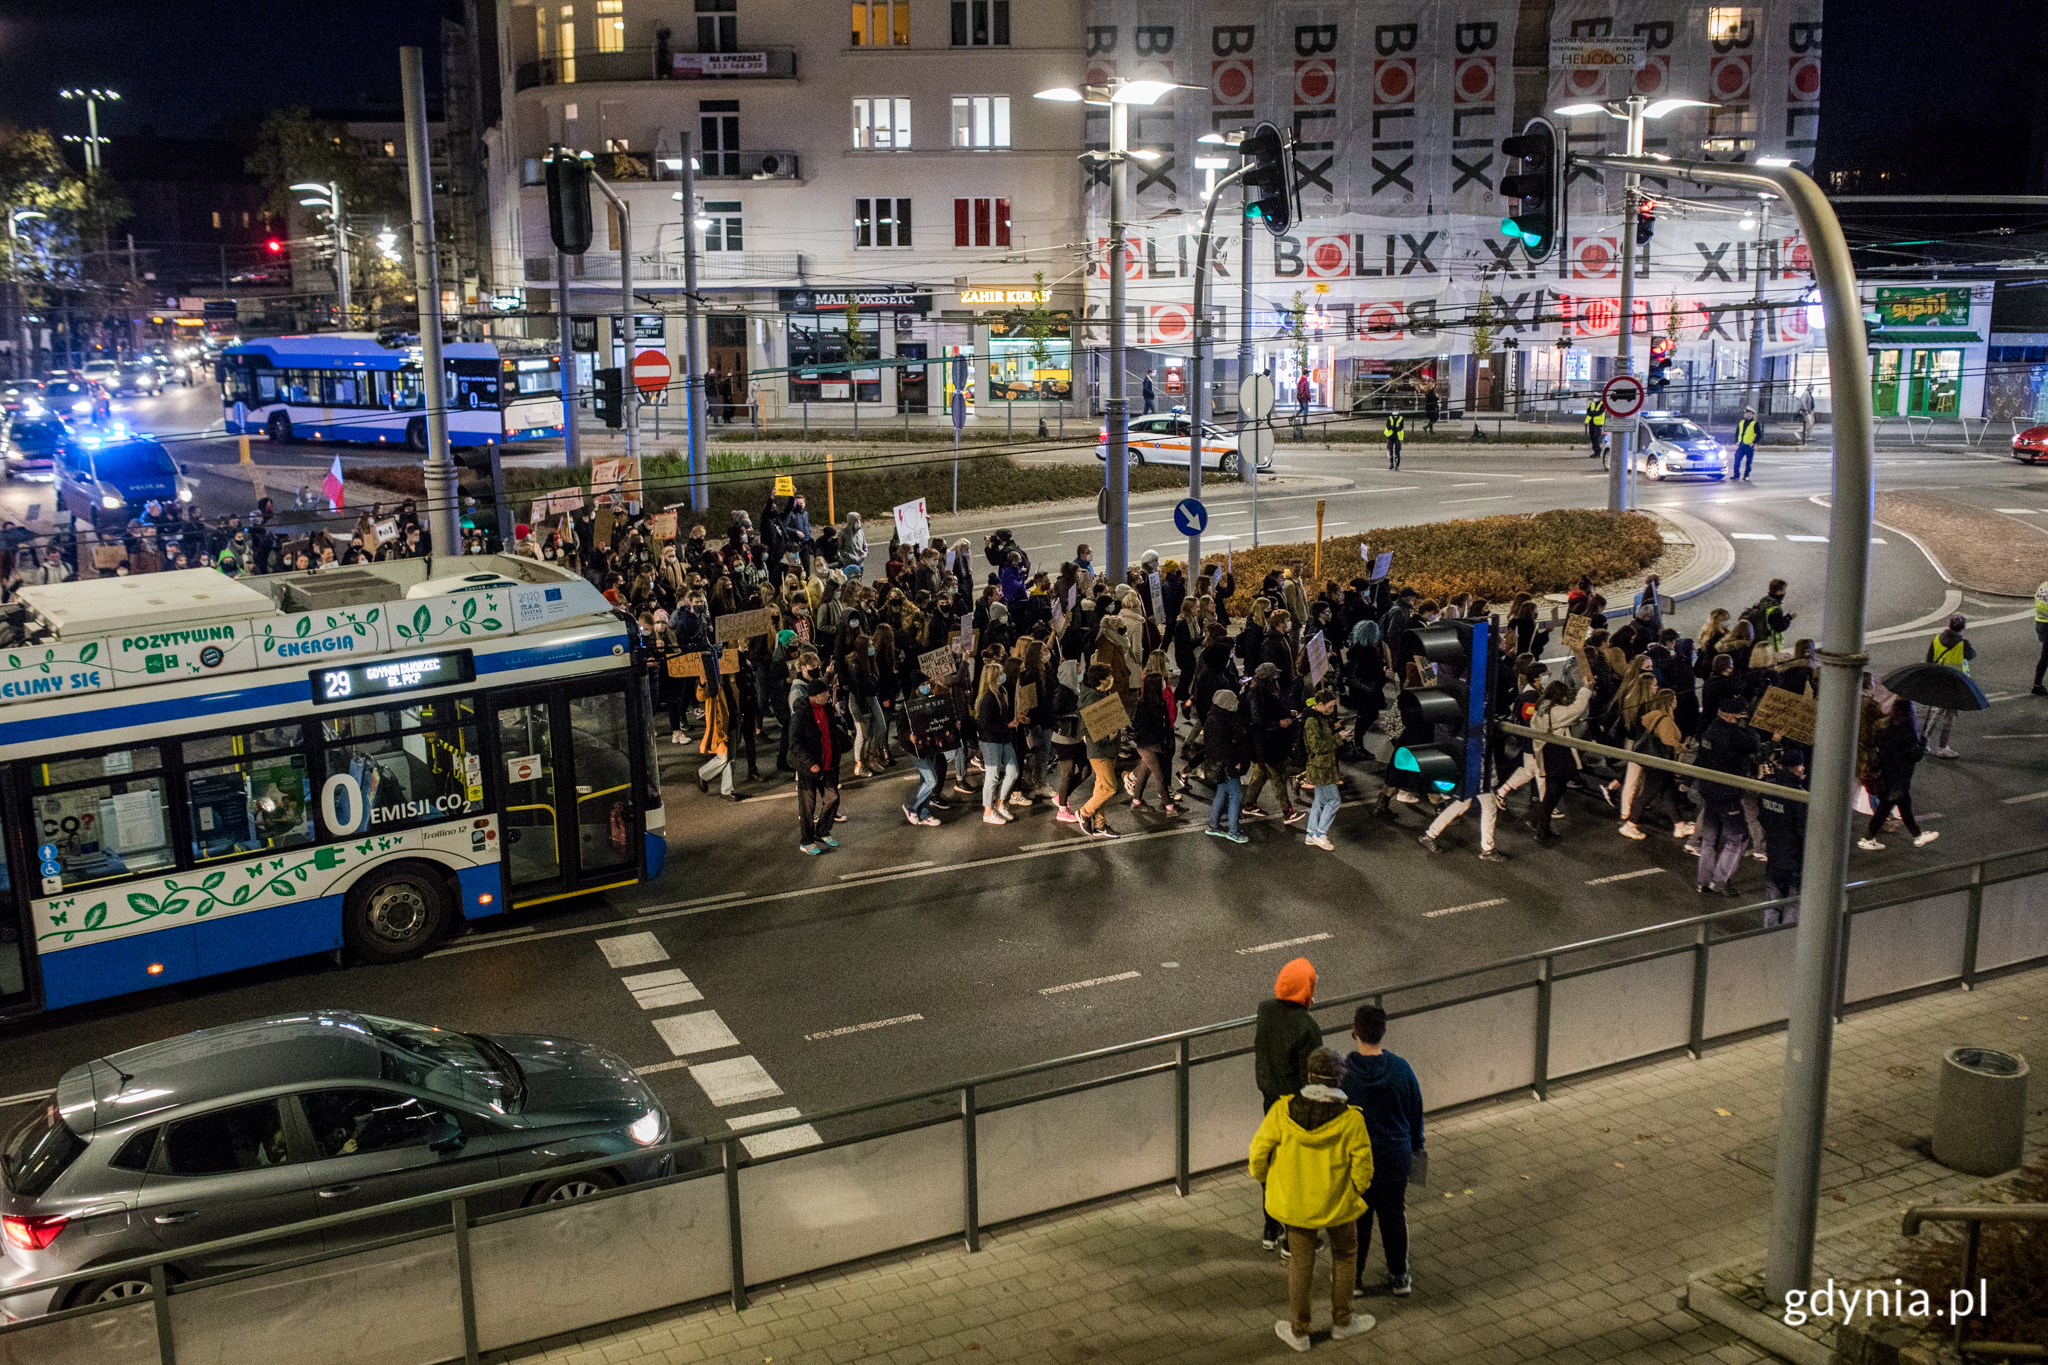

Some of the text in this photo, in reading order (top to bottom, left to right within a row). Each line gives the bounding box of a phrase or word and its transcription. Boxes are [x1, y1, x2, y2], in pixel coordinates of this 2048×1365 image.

[1561, 53, 1635, 65] HELIODOR
[1371, 23, 1417, 196] BOLIX
[1451, 22, 1497, 194] BOLIX
[1274, 230, 1440, 278] BOLIX
[815, 293, 849, 305] MAIL
[960, 290, 1052, 303] ZAHIR KEBAB
[1250, 311, 1297, 331] ING
[129, 483, 166, 491] POLICJA
[517, 591, 540, 604] 2020
[520, 608, 543, 616] CIVITAS
[122, 625, 235, 652] POZYTYWNĄ
[277, 635, 354, 657] ENERGIĄ
[920, 654, 935, 664] WHO
[922, 663, 933, 671] THE
[324, 657, 441, 699] 29 GDYNIA DWORZEC
[669, 665, 686, 676] OD
[71, 671, 101, 690] SIĘ
[402, 673, 422, 685] PKP
[320, 773, 363, 836] 0
[370, 798, 431, 825] EMISJI
[1762, 798, 1785, 814] POLICJA
[422, 825, 468, 841] Trollino 12
